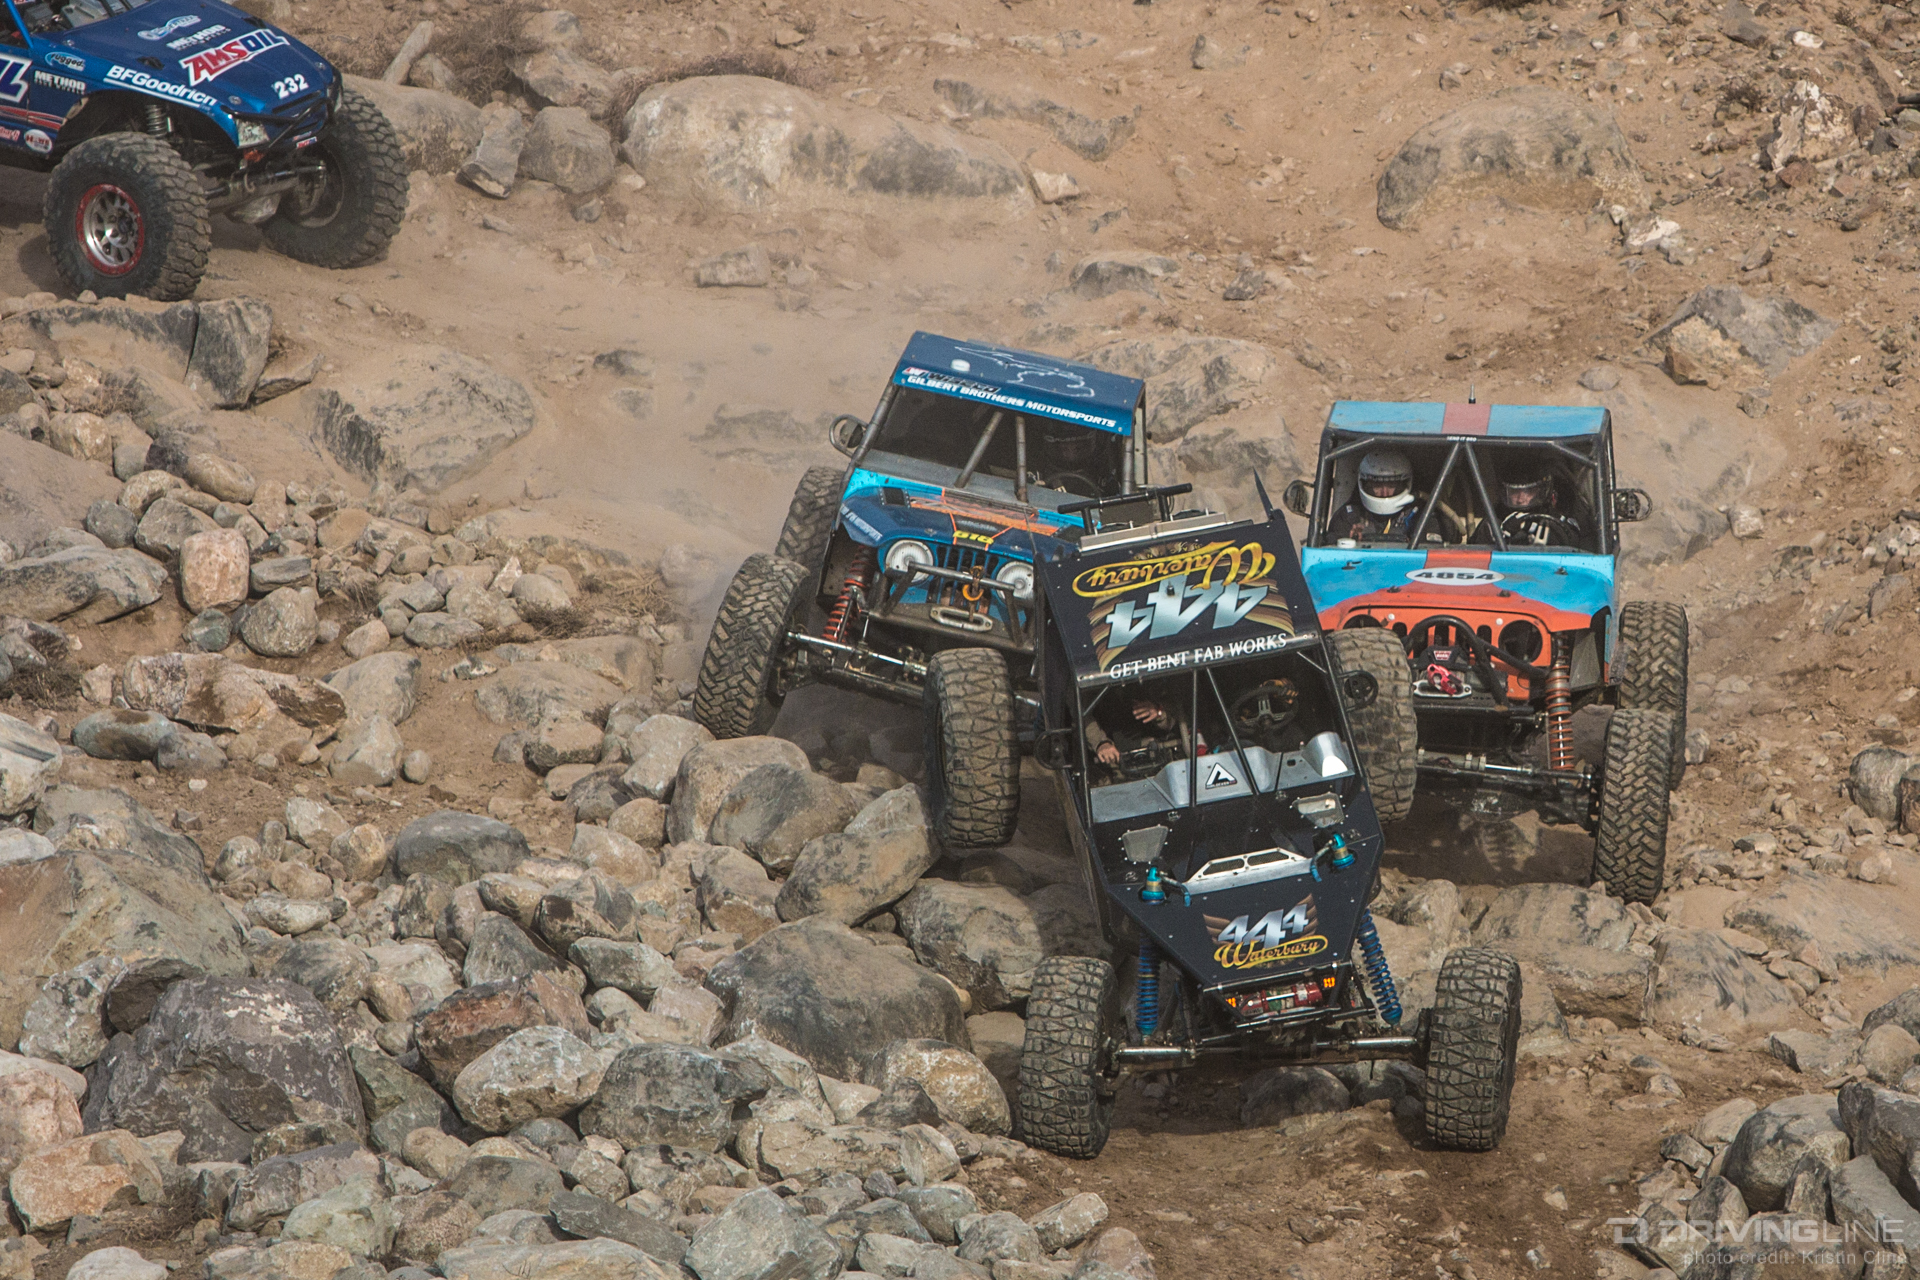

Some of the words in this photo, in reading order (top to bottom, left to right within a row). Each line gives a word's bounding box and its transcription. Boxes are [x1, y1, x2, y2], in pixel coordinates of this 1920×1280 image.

[166, 24, 226, 50] METHOD
[180, 29, 288, 86] AMSOIL
[34, 70, 87, 91] METHOD
[271, 73, 309, 99] 232
[907, 375, 960, 393] GILBERT
[959, 385, 1026, 407] BROTHERS
[1025, 400, 1117, 428] MOTORSPORTS
[1084, 541, 1276, 590] Waterbury
[1414, 571, 1496, 581] 4854
[1105, 574, 1270, 649] 444
[1110, 658, 1143, 680] GET
[1146, 650, 1190, 673] BENT
[1193, 645, 1224, 665] FAB
[1228, 632, 1288, 658] WORKS
[1217, 903, 1310, 949] 444
[1213, 940, 1321, 969] Waterbury
